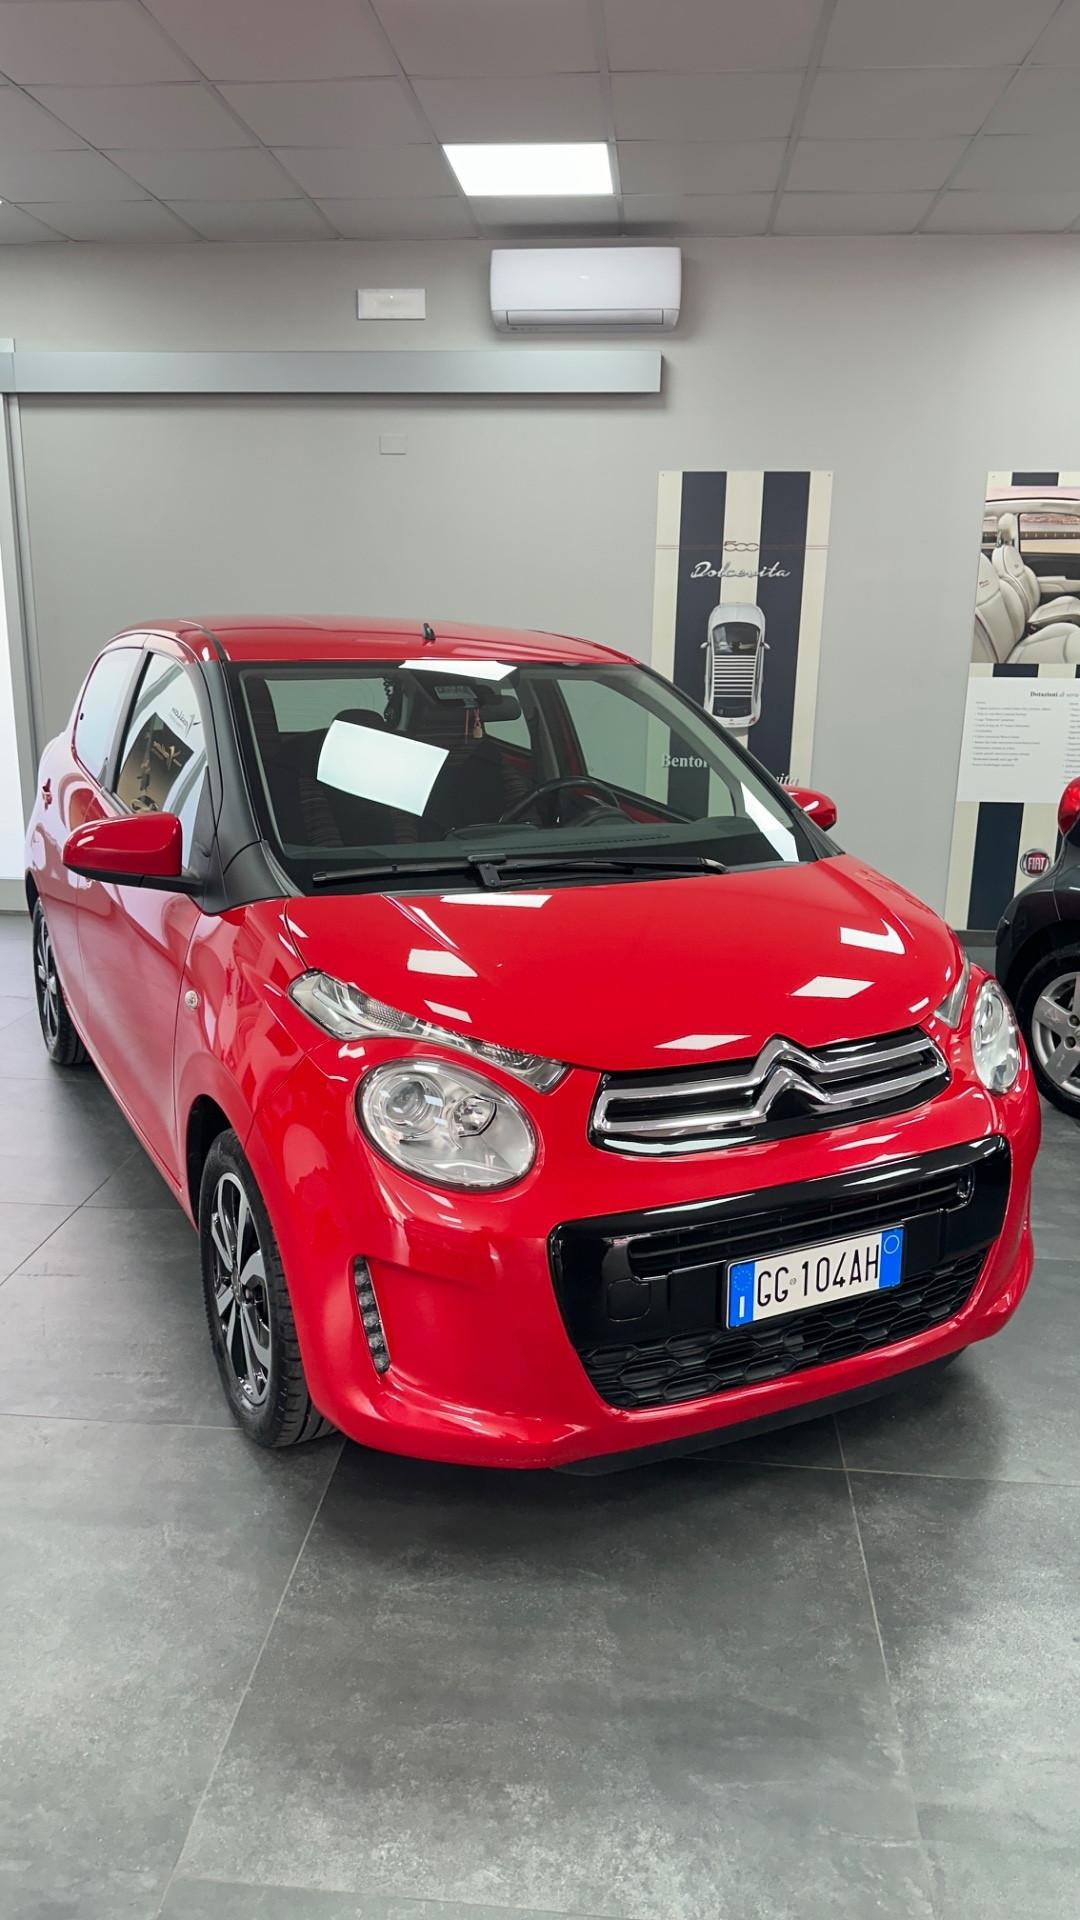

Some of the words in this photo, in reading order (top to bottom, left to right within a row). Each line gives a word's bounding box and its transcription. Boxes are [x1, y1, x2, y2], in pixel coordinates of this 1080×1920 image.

[724, 540, 759, 552] 500
[690, 561, 791, 578] Dolcevita
[1027, 857, 1047, 871] FIAT
[757, 1266, 789, 1307] GG
[801, 1244, 880, 1297] 104AH
